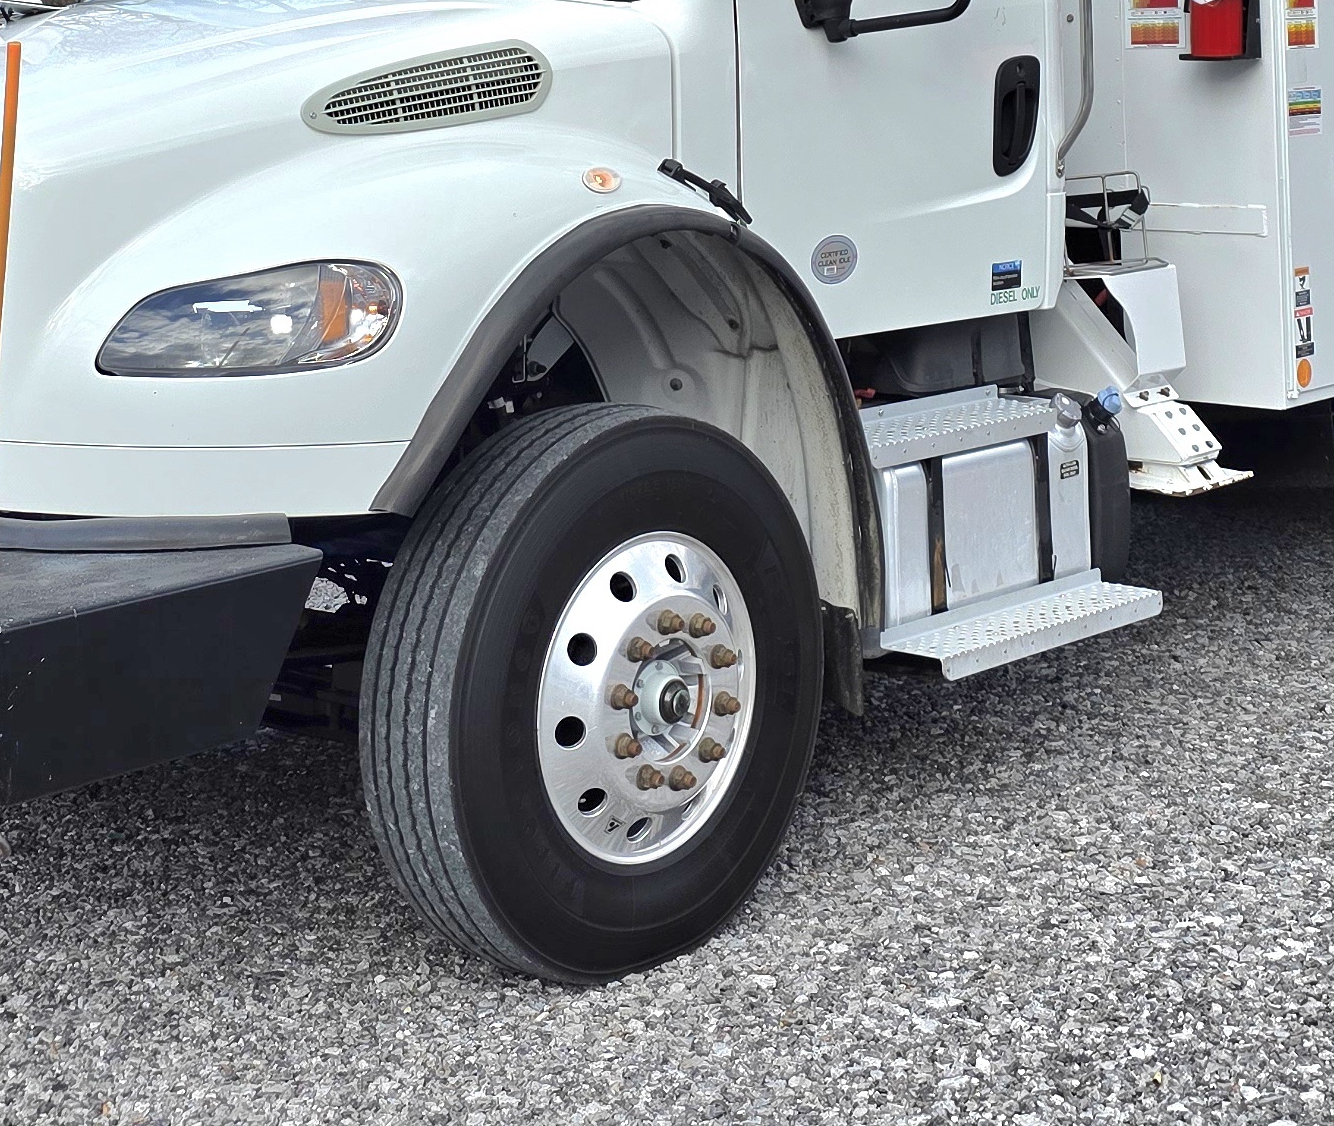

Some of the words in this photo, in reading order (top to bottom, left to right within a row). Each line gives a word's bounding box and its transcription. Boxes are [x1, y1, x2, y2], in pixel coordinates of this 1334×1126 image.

[820, 249, 848, 258] CERTIFIED
[818, 259, 837, 267] CLEAN
[839, 256, 851, 264] IDLE
[990, 290, 1017, 305] DIESEL
[1022, 286, 1040, 300] ONLY
